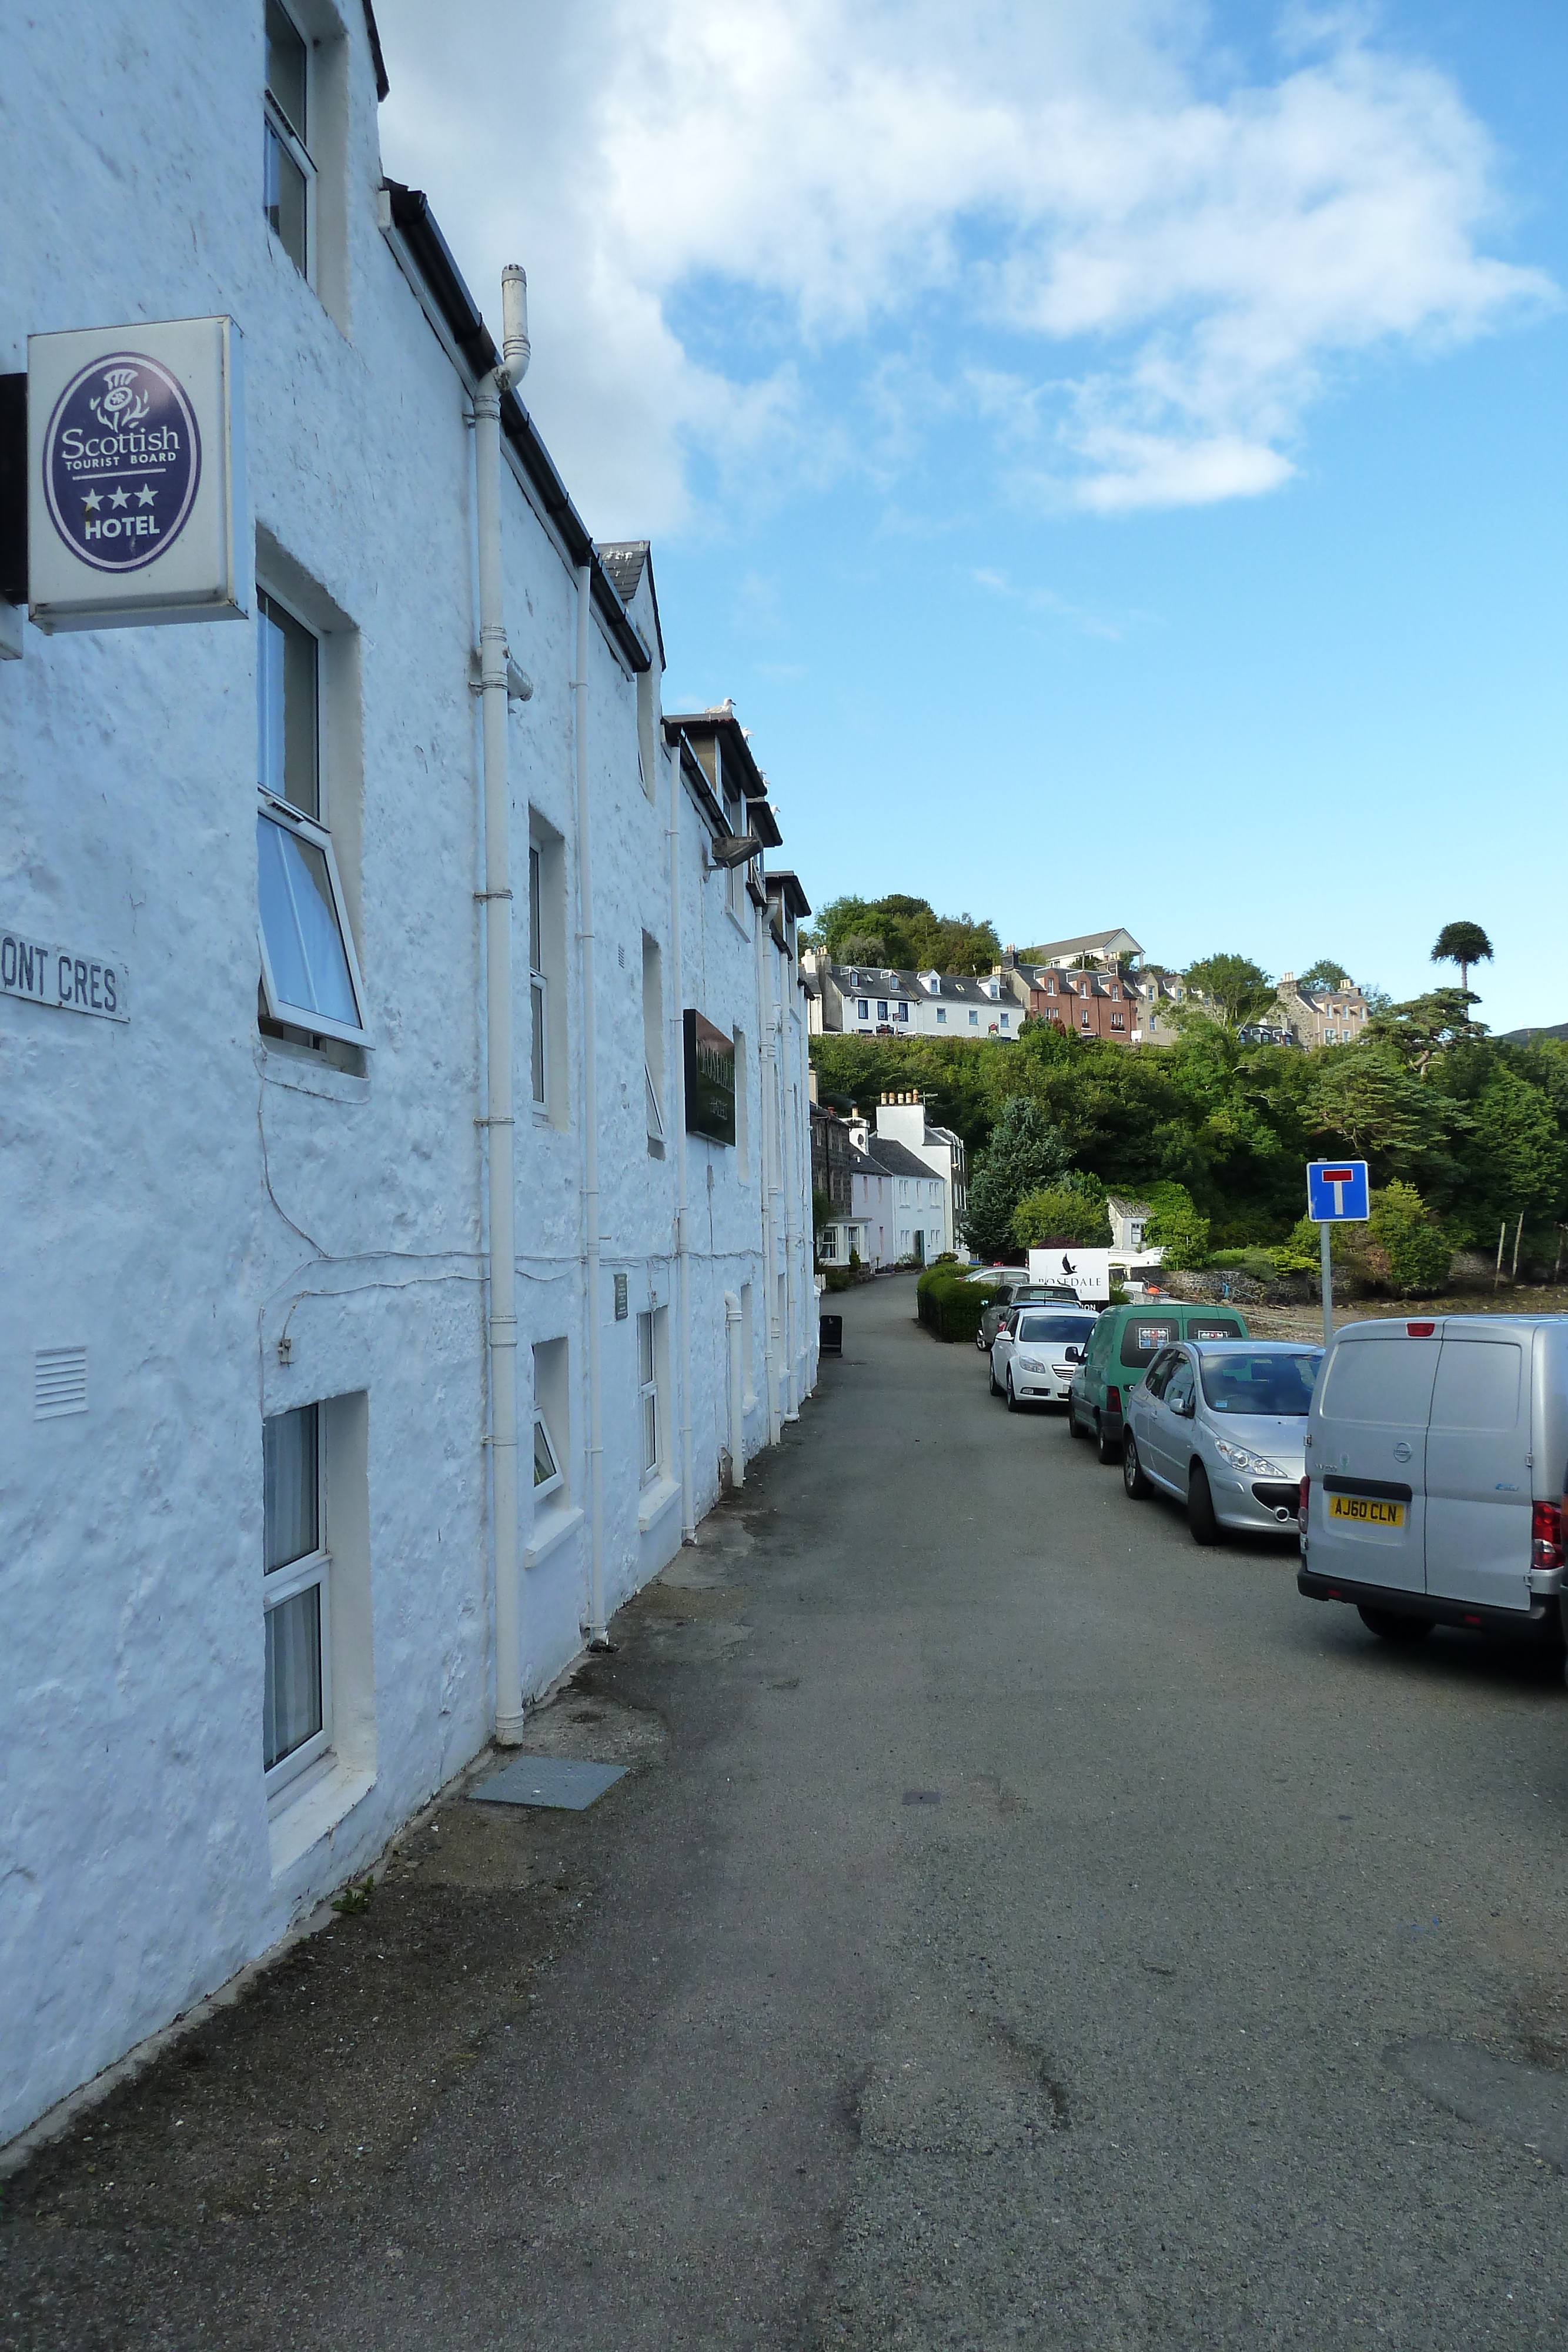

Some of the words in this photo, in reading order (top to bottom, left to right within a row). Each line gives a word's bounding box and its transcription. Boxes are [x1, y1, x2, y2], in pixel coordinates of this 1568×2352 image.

[62, 426, 180, 459] Scottish
[65, 456, 120, 470] TOURIST
[131, 452, 176, 465] BOARD
[85, 515, 161, 540] HOTEL
[59, 956, 116, 1012] CRES
[1335, 1498, 1367, 1518] AJ60
[1370, 1503, 1397, 1522] CLN
